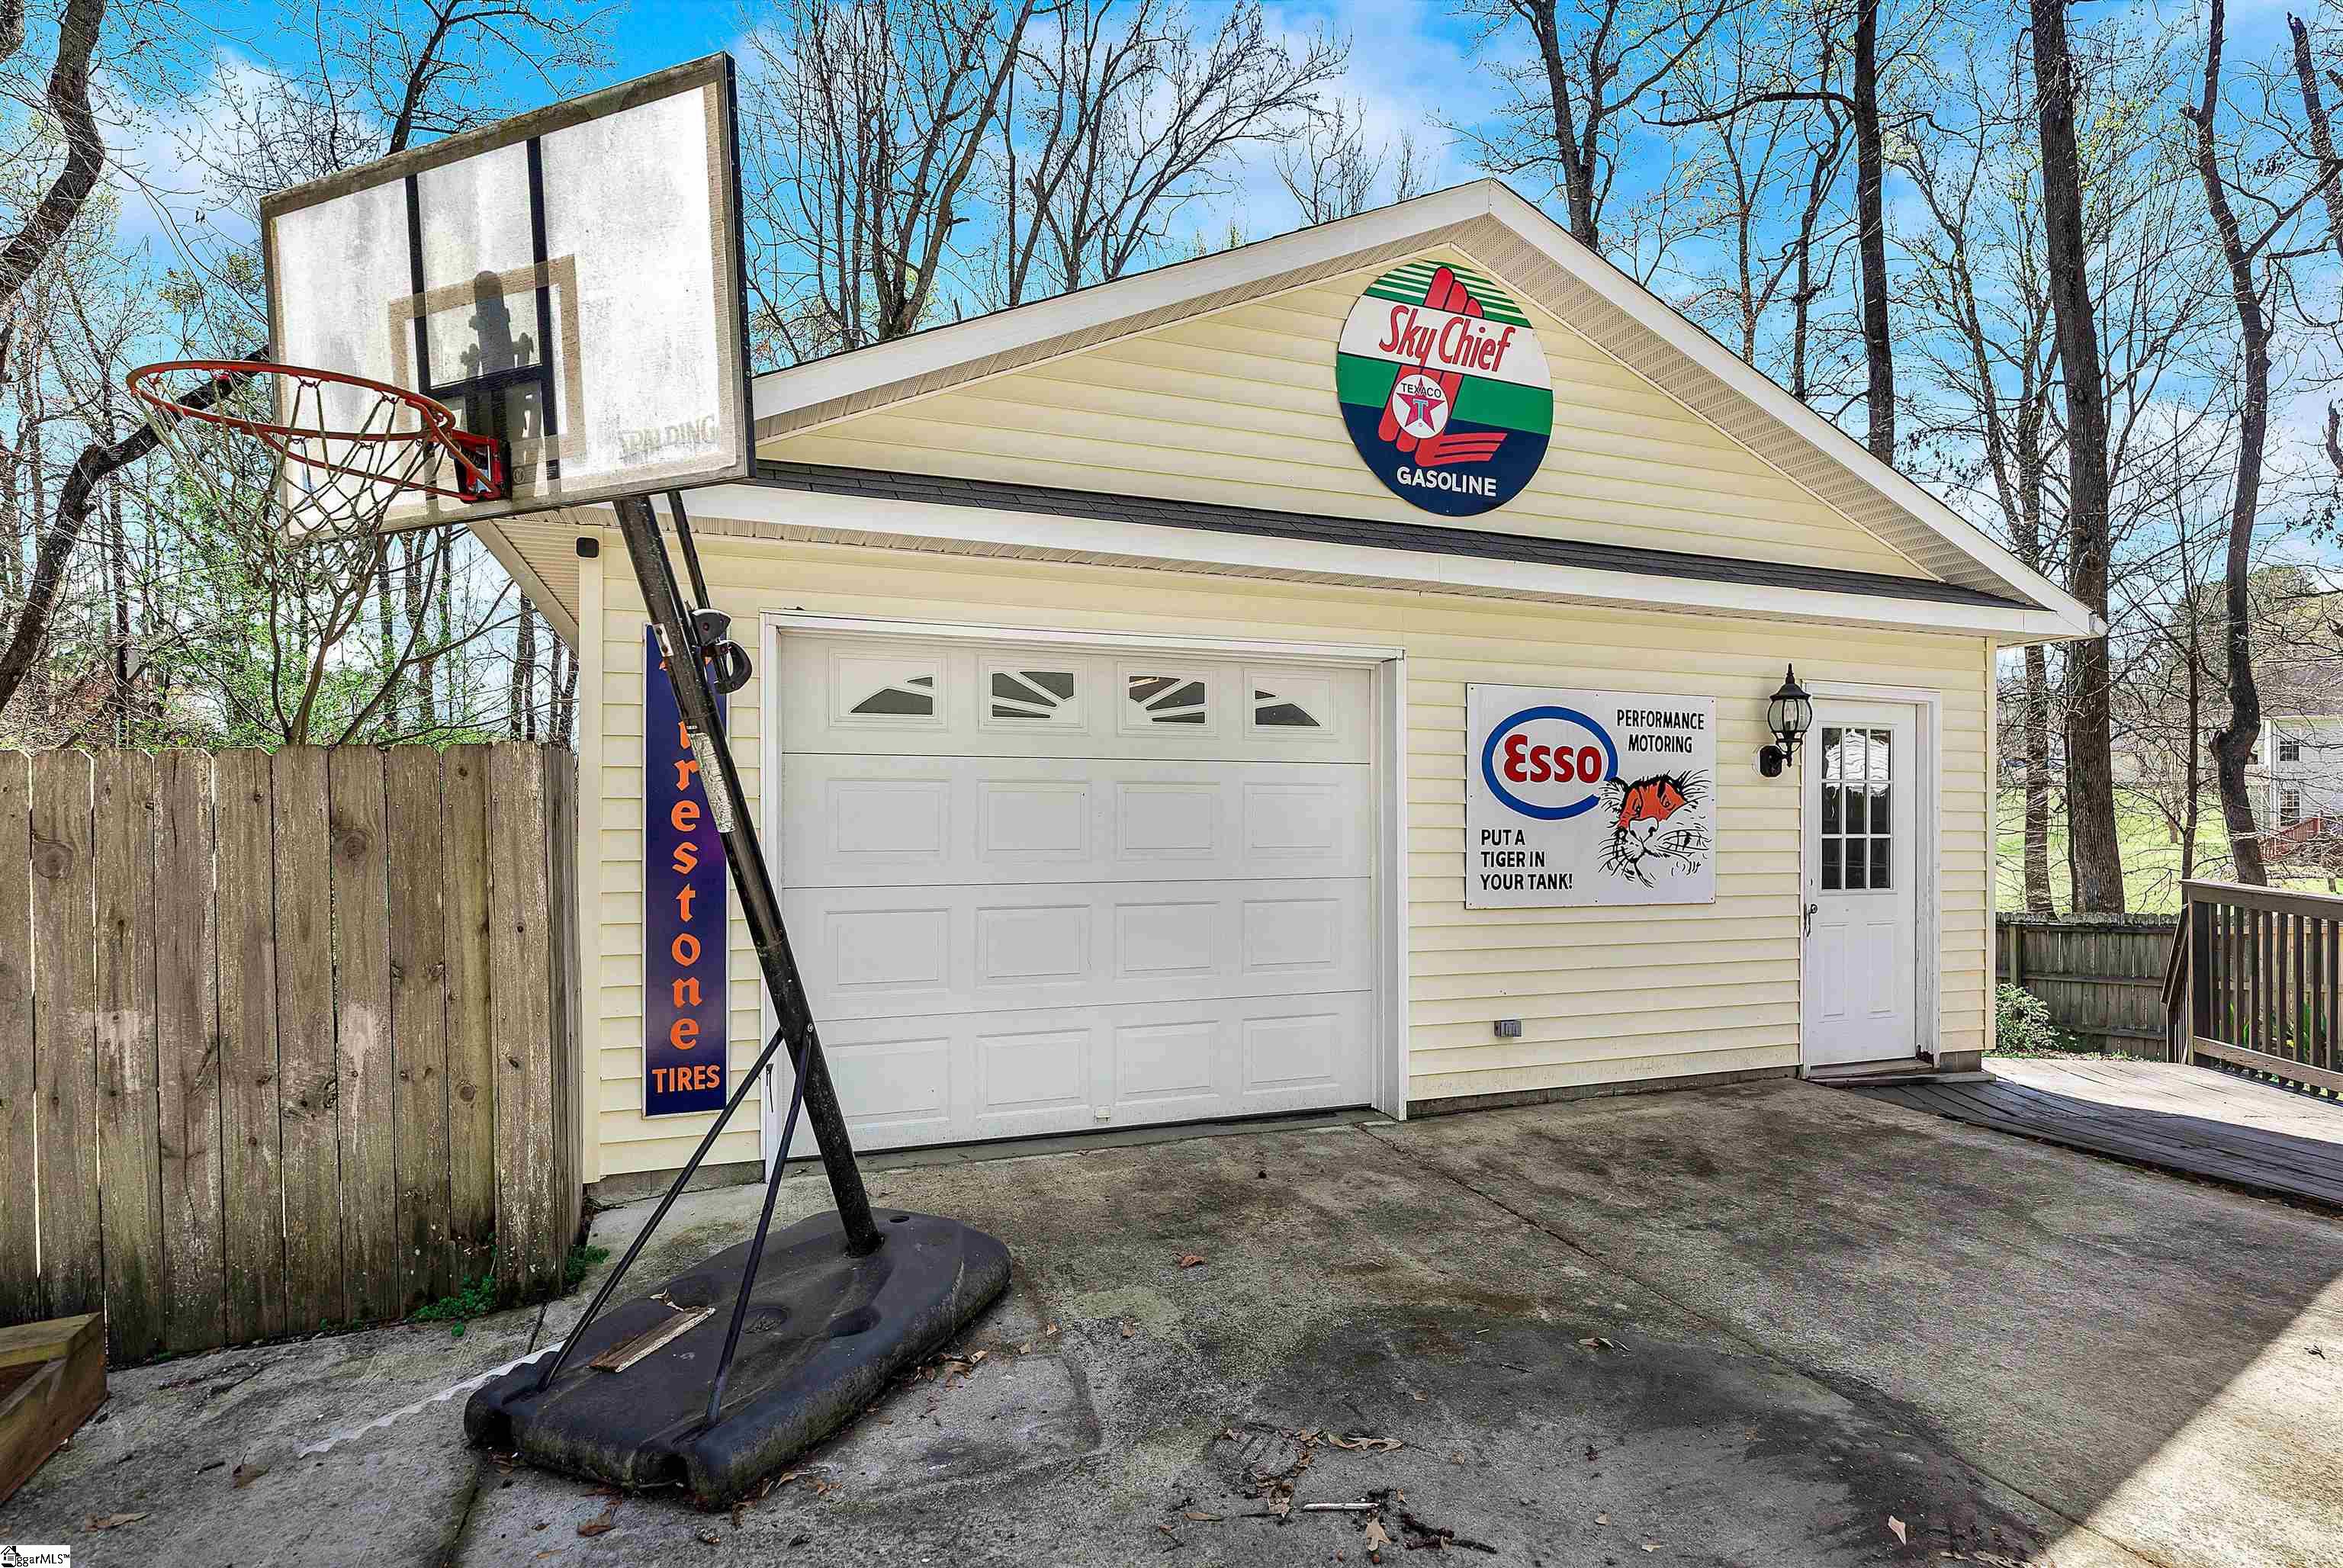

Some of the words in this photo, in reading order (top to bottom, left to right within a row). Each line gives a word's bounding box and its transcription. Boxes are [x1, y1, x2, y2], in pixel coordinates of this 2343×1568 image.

[1379, 304, 1438, 368] Sky
[1438, 316, 1515, 372] Chief
[1401, 383, 1441, 397] TEXACO
[1413, 397, 1429, 420] T
[1396, 466, 1496, 496] GASOLINE
[1617, 709, 1705, 730] PERFORMANCE
[1628, 734, 1692, 753] MOTORING
[1481, 829, 1512, 846] PUT
[1515, 829, 1525, 845] A
[1481, 851, 1525, 867] TIGER
[1529, 851, 1545, 867] IN
[1480, 874, 1524, 890] YOUR
[1528, 873, 1573, 890] TANK!
[652, 1065, 721, 1093] TIRES
